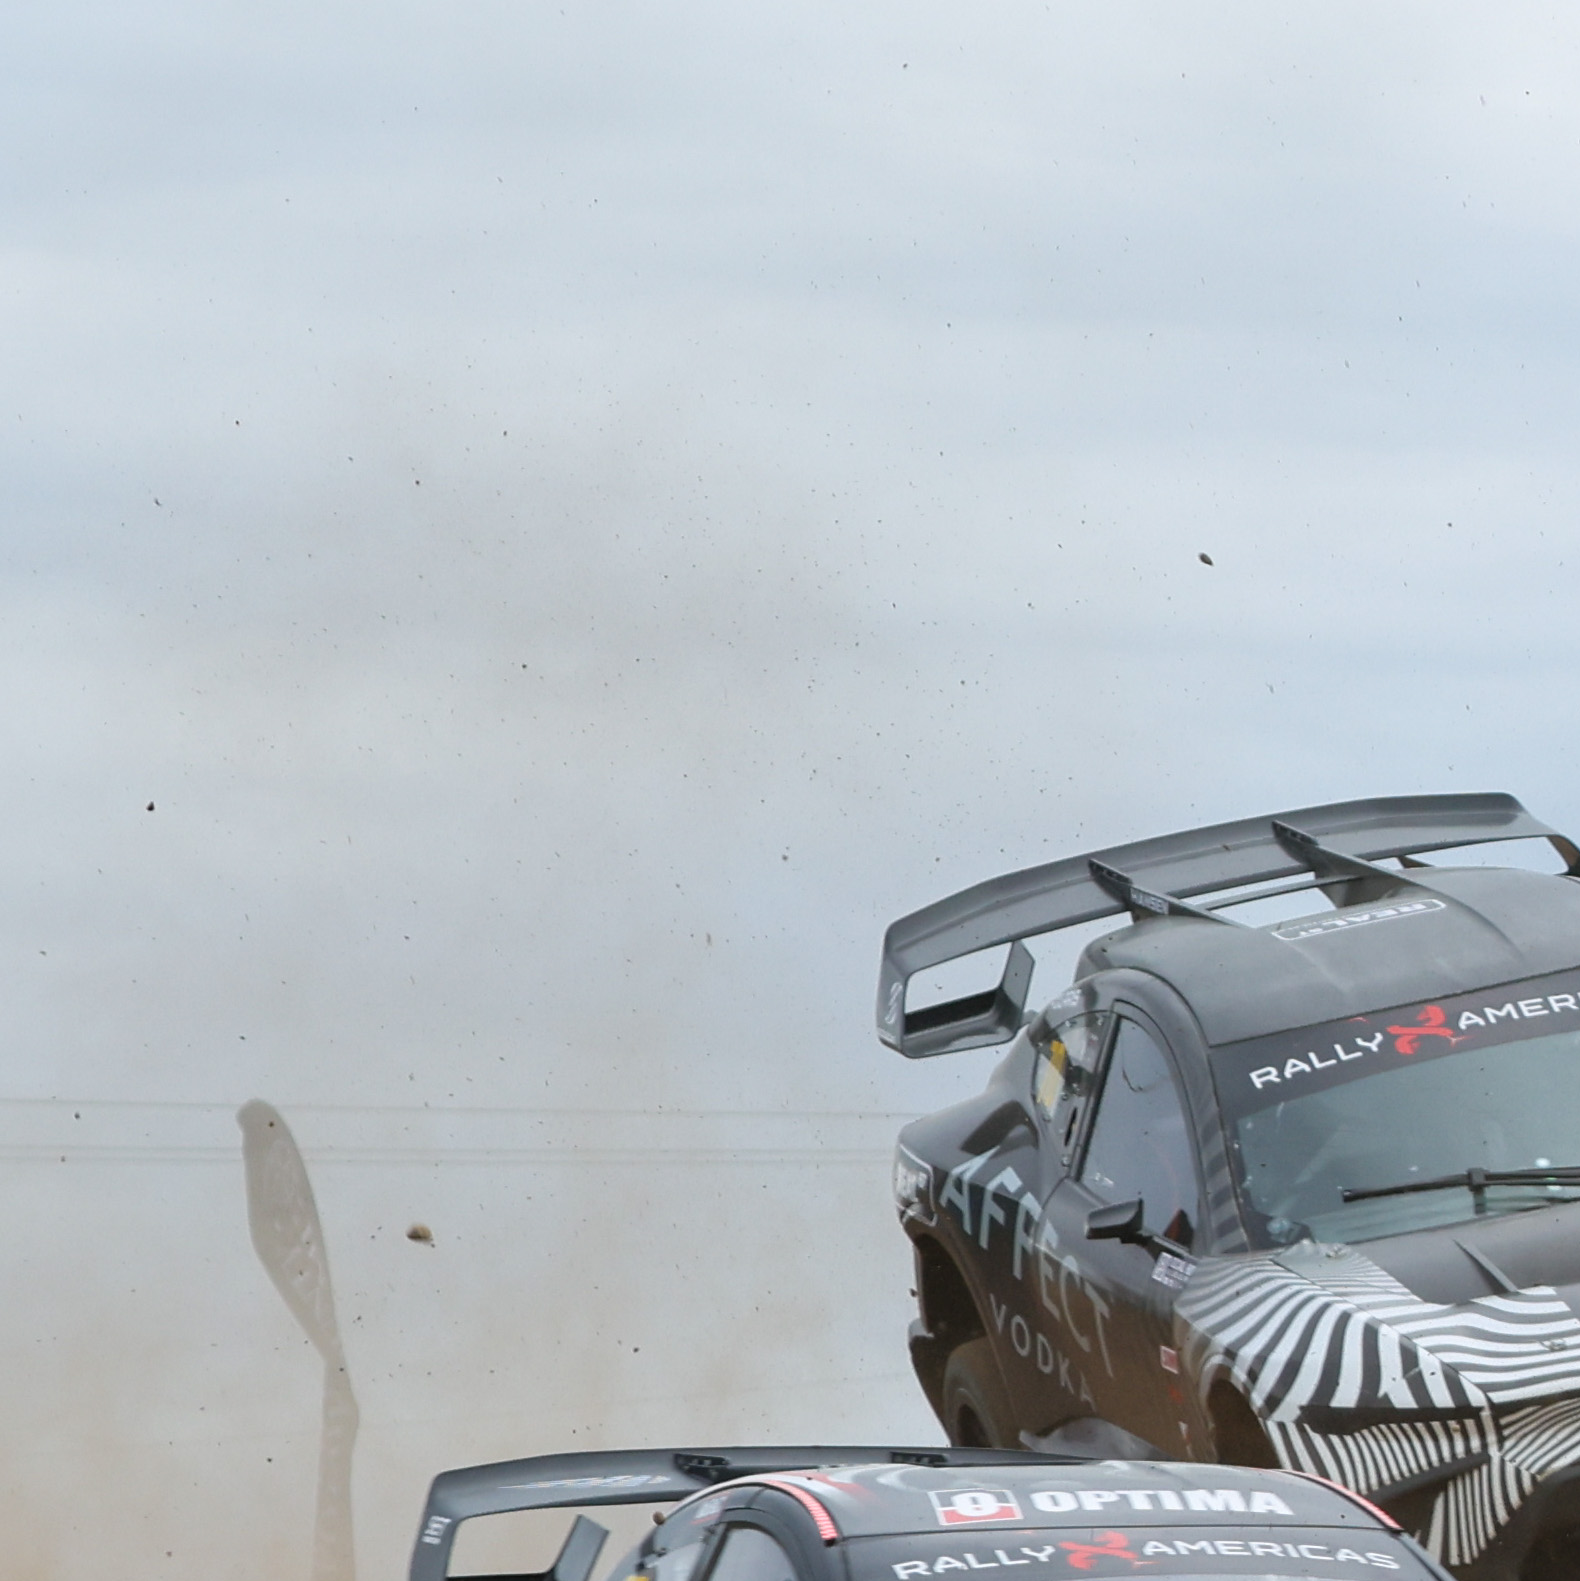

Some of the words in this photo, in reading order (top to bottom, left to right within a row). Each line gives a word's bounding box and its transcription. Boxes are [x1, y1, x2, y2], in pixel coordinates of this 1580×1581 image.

[1249, 1031, 1385, 1090] RALLY
[989, 1295, 1097, 1412] VODKA
[1030, 1490, 1295, 1516] OPTIMA
[892, 1545, 1057, 1581] RALLY
[1141, 1540, 1401, 1570] AMERICAS
